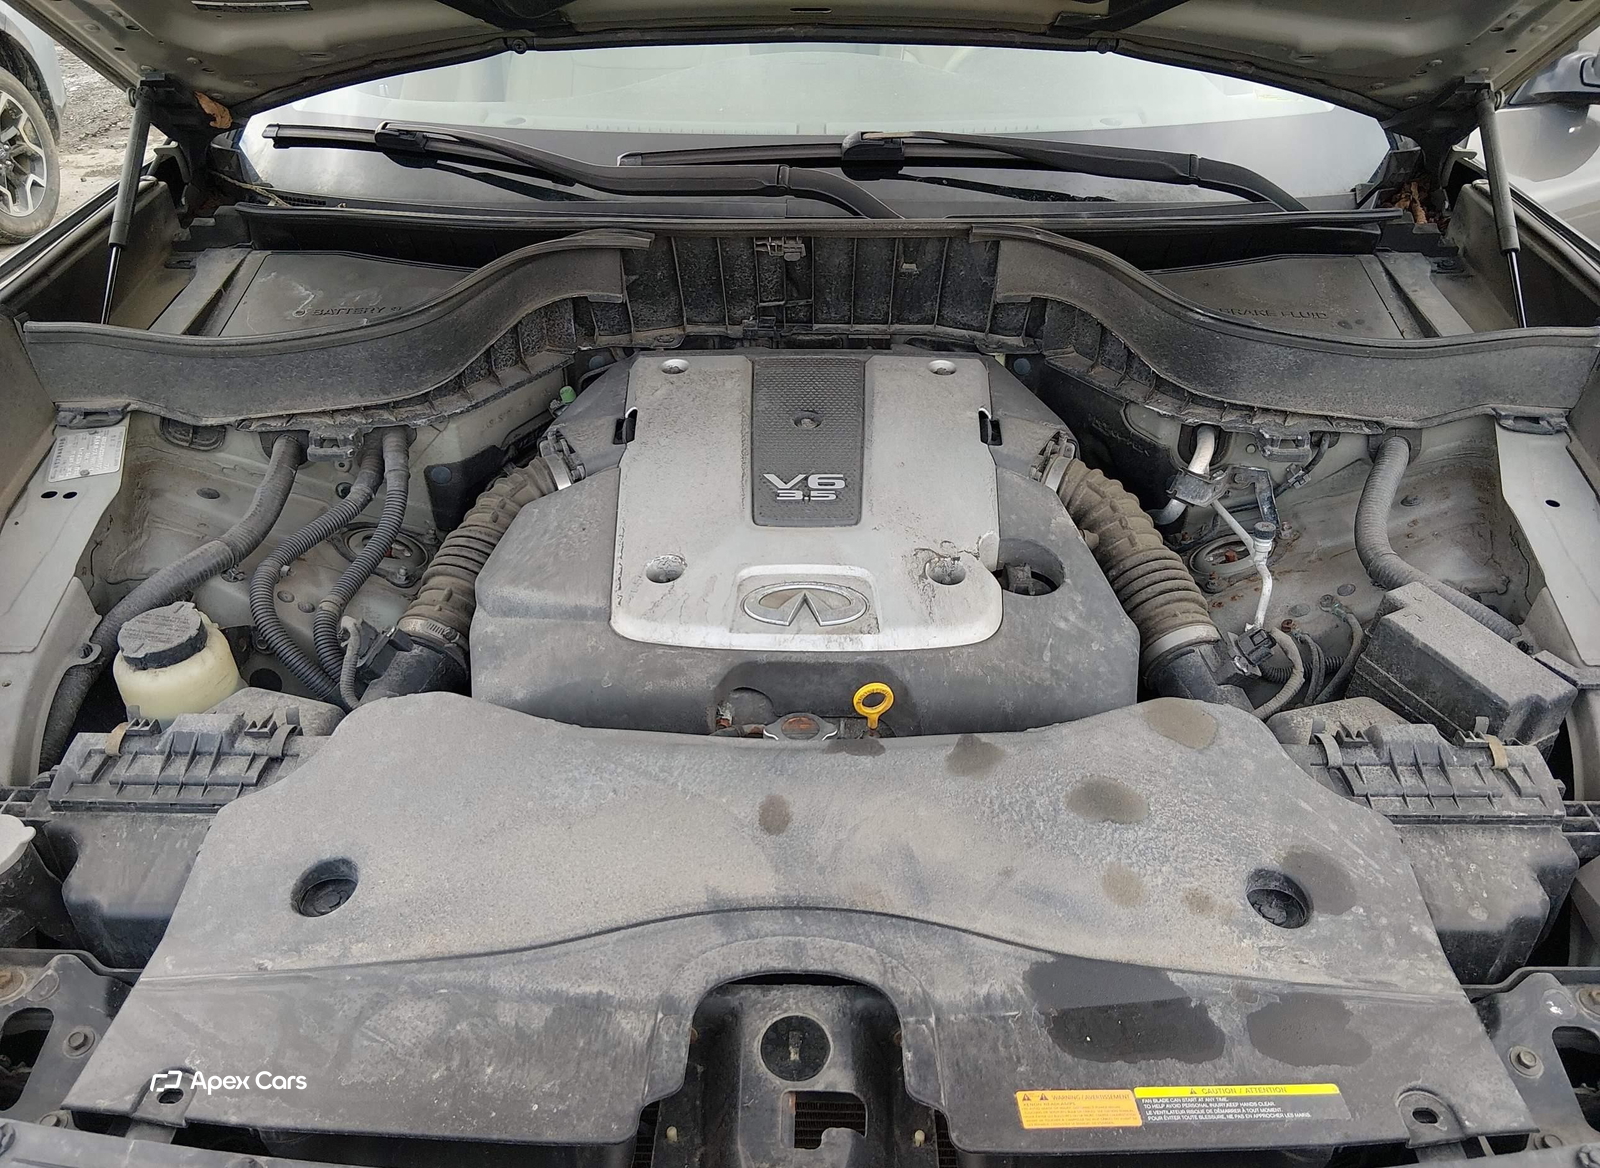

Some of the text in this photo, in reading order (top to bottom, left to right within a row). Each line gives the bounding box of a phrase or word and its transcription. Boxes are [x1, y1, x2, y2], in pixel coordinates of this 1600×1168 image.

[312, 306, 386, 316] BATTERY
[763, 473, 846, 489] V6
[776, 490, 837, 500] 3.5
[1201, 1087, 1237, 1095] CAUTION
[1245, 1086, 1288, 1094] ATTENTION
